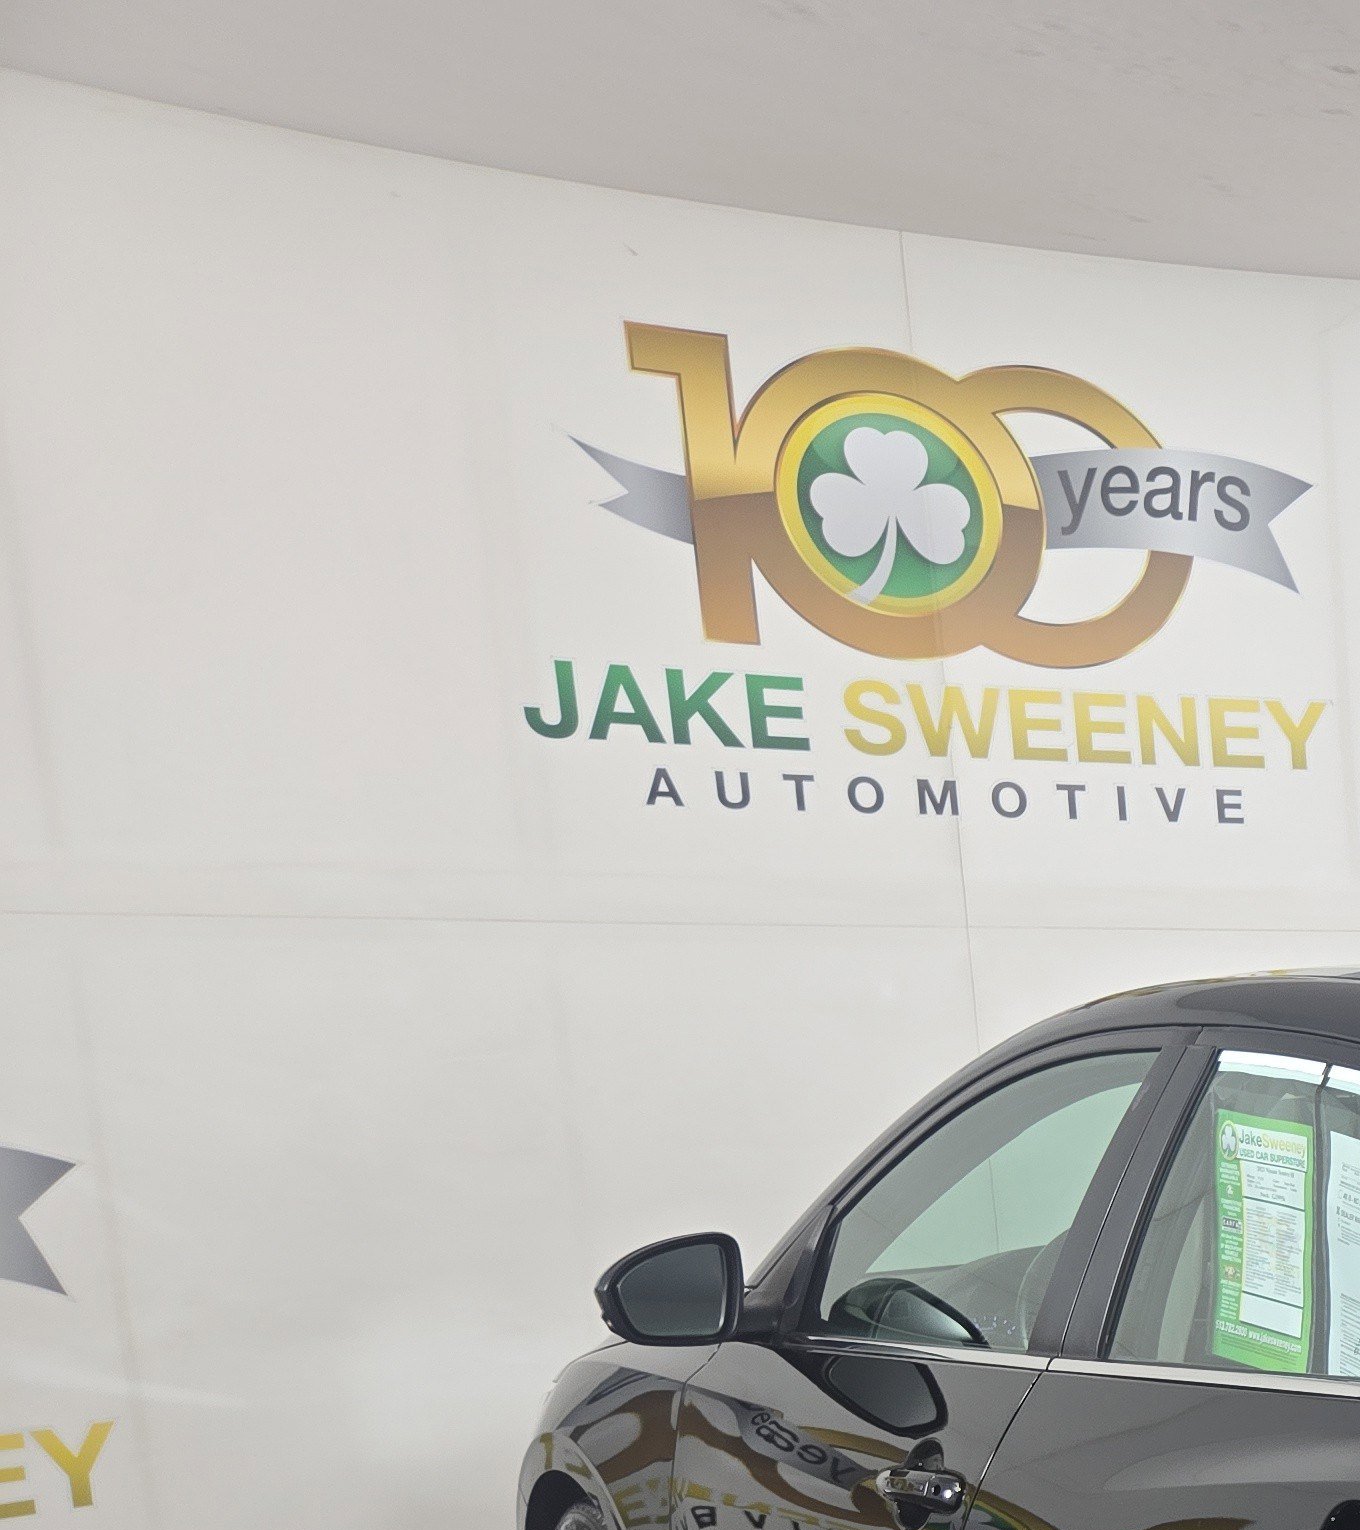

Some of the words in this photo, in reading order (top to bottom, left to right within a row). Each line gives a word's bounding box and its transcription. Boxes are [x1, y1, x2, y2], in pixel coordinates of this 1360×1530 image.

[1056, 456, 1252, 536] years
[523, 659, 811, 752] JAKE
[842, 679, 1328, 771] SWEENEY
[645, 767, 1246, 825] AUTOMOTIVE
